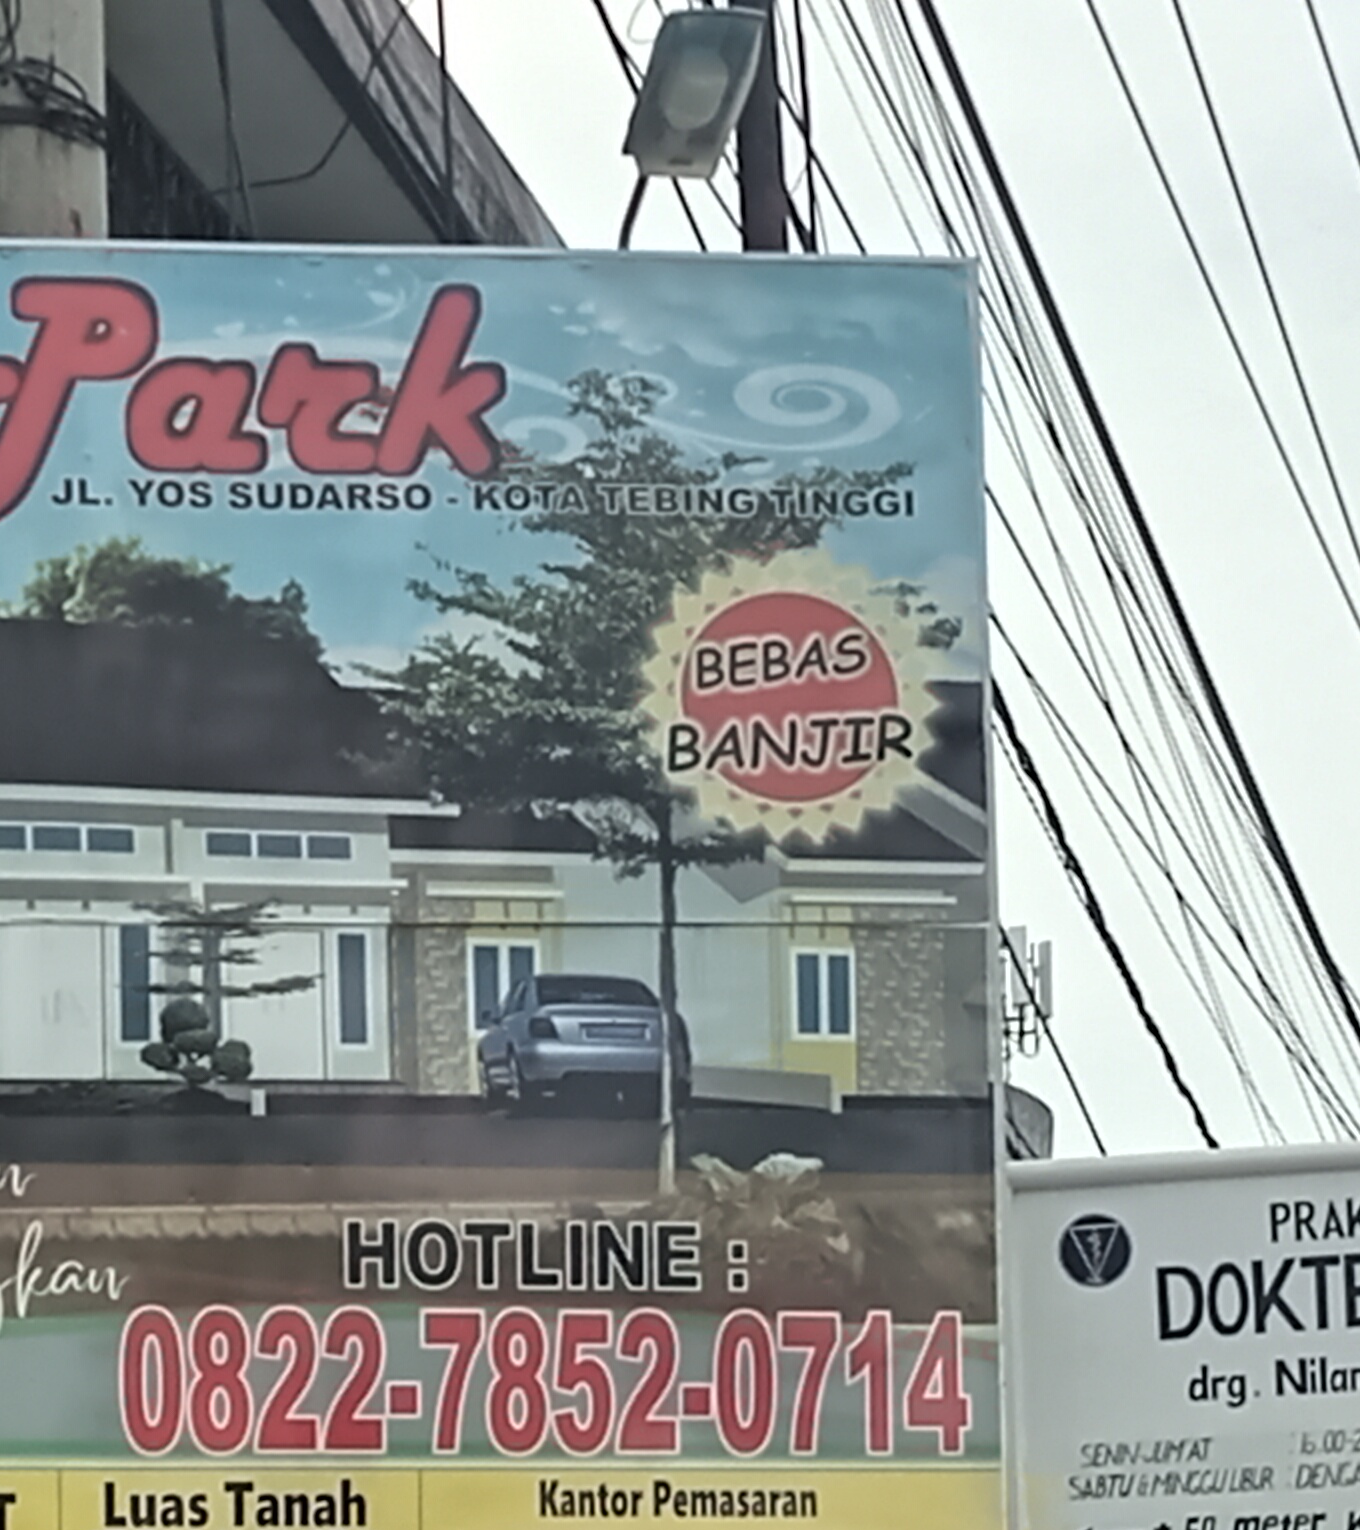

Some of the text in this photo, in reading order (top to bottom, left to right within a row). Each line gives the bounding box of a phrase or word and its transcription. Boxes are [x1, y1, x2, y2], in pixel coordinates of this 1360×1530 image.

[51, 480, 115, 508] JL.
[128, 480, 213, 510] YOS
[227, 481, 433, 511] SUDARSO
[473, 482, 585, 515] KOTA
[596, 482, 758, 518] TEBING
[767, 486, 916, 519] TINGGI
[690, 631, 870, 694] BEBAS
[665, 713, 916, 774] BANJIR
[342, 1219, 701, 1292] HOTLINE
[117, 1304, 972, 1457] 0822-7852-0714
[1187, 1365, 1262, 1408] drg.
[102, 1481, 368, 1529] Luas Tanah
[538, 1480, 819, 1520] Kantor Pemasaran
